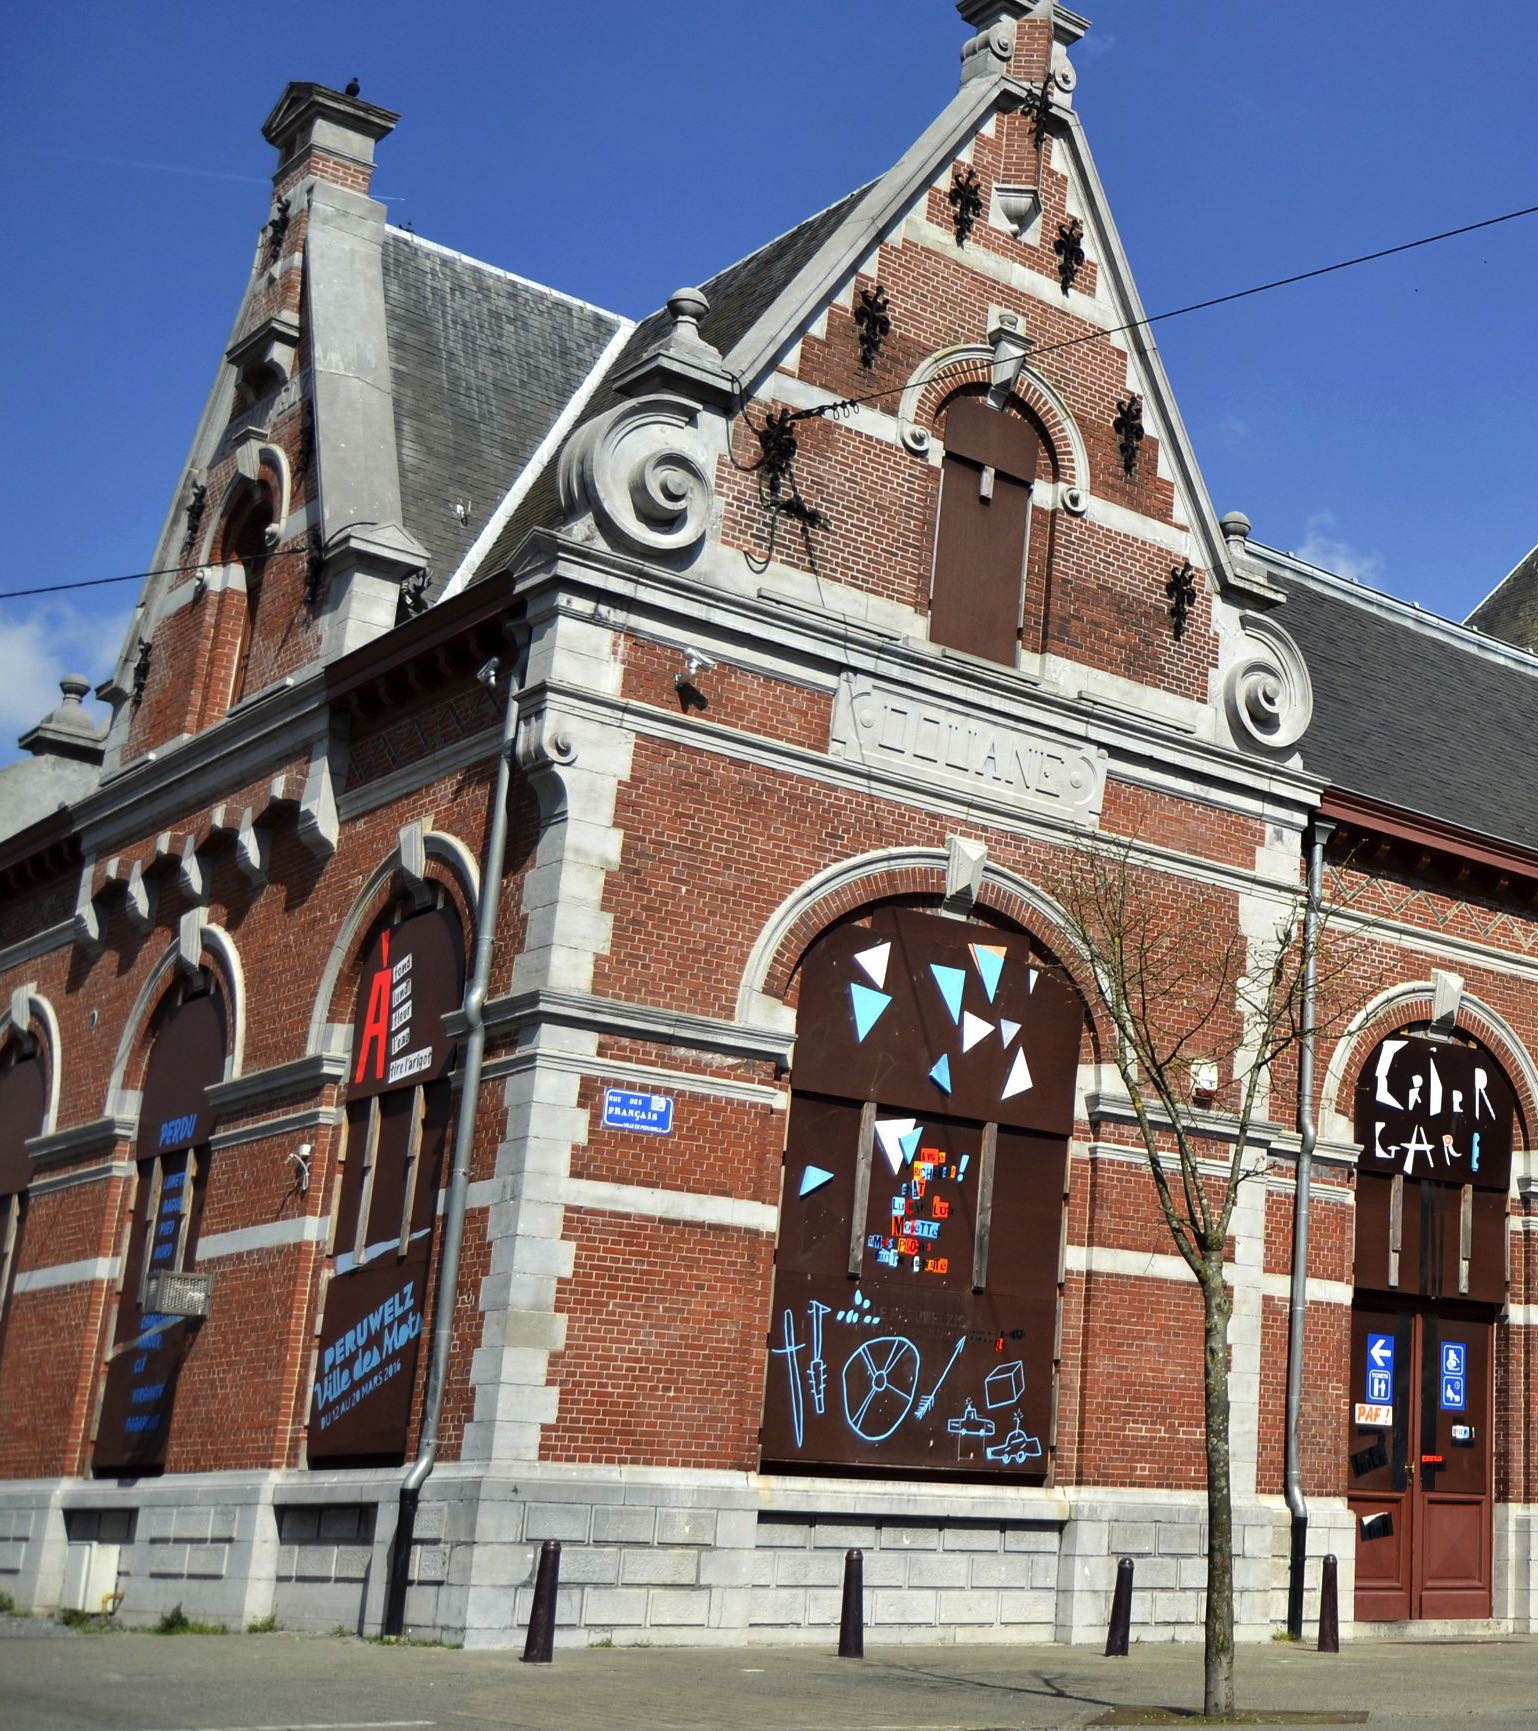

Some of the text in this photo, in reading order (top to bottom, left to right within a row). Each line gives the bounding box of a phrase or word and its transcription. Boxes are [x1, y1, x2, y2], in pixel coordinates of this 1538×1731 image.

[608, 1106, 658, 1121] FRANÇAIS
[609, 1094, 643, 1106] RUE DES
[159, 1113, 198, 1146] PERDU
[1375, 1121, 1481, 1175] GARE
[324, 1280, 415, 1373] PERUWELZ
[315, 1366, 350, 1410] Ville
[353, 1346, 381, 1381] des
[361, 1372, 383, 1400] MARS
[383, 1358, 402, 1382] 2016
[1357, 1405, 1382, 1422] PAF
